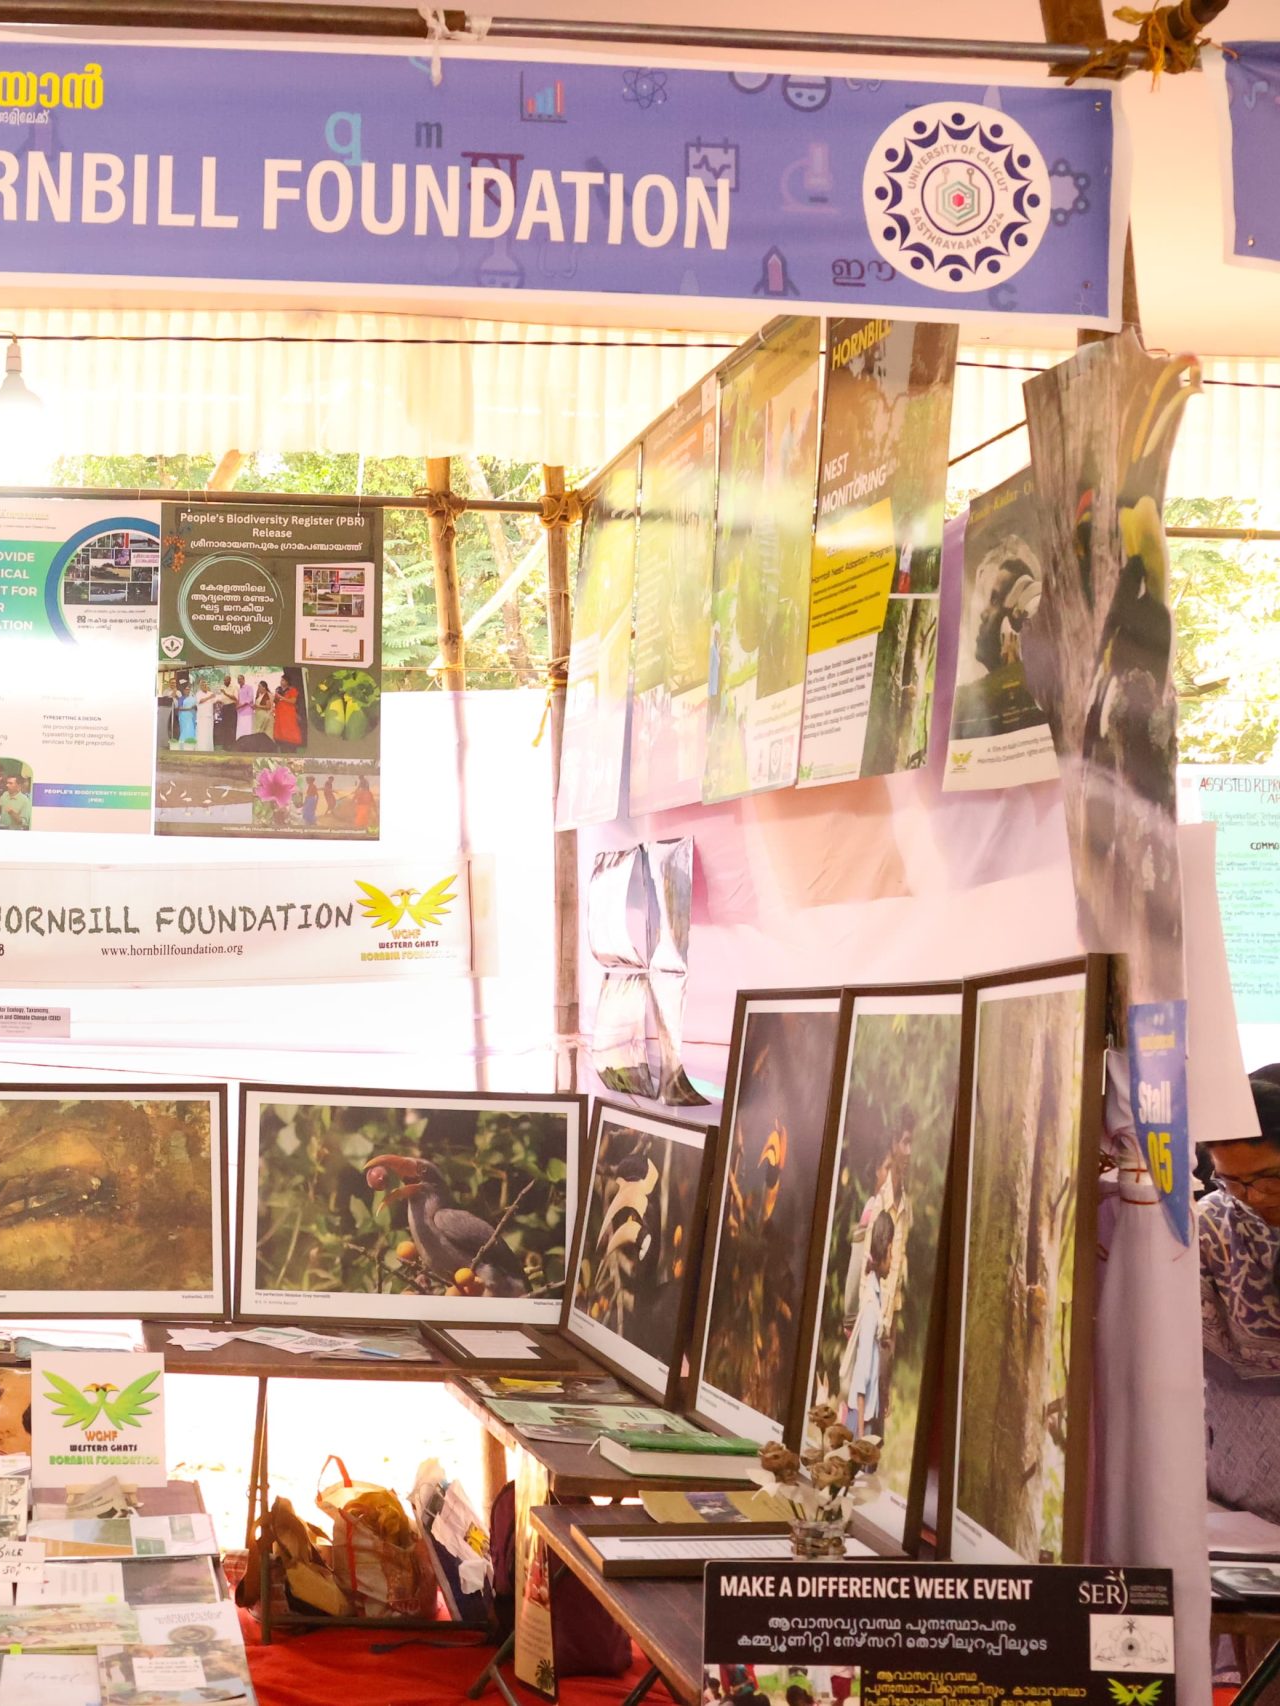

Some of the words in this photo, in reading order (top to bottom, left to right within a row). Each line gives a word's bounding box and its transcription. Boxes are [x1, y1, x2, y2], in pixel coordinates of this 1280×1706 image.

[907, 143, 958, 190] UNIVERSITY
[960, 144, 977, 156] OF
[976, 151, 1009, 193] CALICUT
[262, 157, 732, 252] FOUNDATION
[910, 207, 983, 251] SASTHRAYAAN
[981, 212, 1005, 240] 2024
[823, 451, 850, 483] NEST
[820, 464, 888, 516] MONITORING
[226, 513, 289, 527] Biodiversity
[291, 515, 334, 528] Register
[335, 516, 365, 528] (PBR)
[252, 528, 293, 539] Release
[10, 586, 38, 597] FOR
[155, 901, 355, 937] FOUNDATION
[378, 940, 412, 950] WESTERN
[414, 939, 439, 948] GHATS
[391, 928, 422, 940] WGHF
[100, 942, 244, 957] www.hornbillfoundation.org
[1137, 1080, 1172, 1124] Stall
[1147, 1131, 1173, 1195] 05
[83, 1429, 118, 1442] WGHF
[69, 1443, 107, 1453] WESTERN
[108, 1443, 138, 1452] GHATS
[720, 1575, 776, 1598] MAKE
[779, 1577, 793, 1598] A
[796, 1576, 911, 1600] DIFFERENCE
[913, 1577, 970, 1600] WEEK
[973, 1578, 1033, 1601] EVENT
[1078, 1582, 1123, 1605] SER
